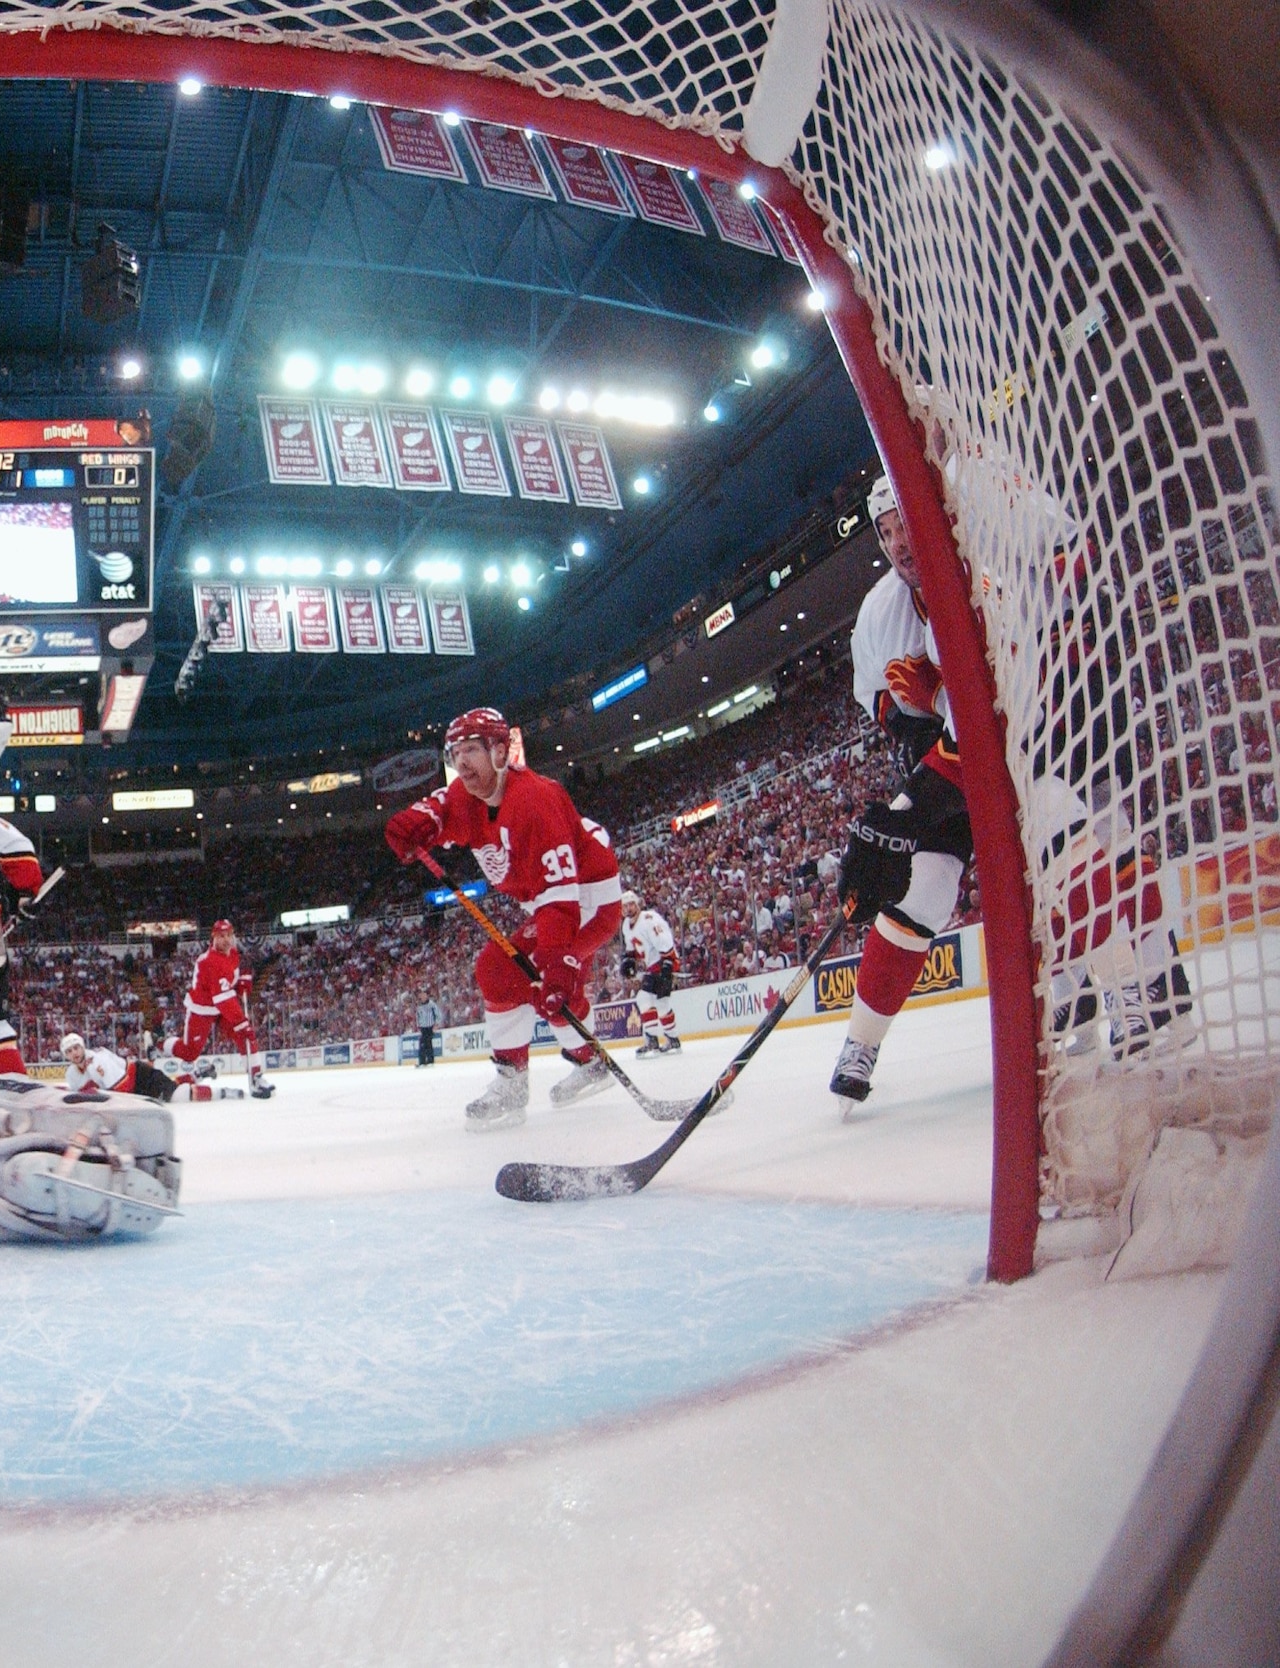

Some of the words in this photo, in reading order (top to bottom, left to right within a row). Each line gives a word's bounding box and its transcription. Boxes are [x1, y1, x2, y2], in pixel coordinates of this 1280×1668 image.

[395, 135, 438, 148] CENTRAL
[397, 144, 443, 157] DIVISION
[395, 154, 452, 168] CHAMPIONS
[279, 448, 312, 456] CENTRAL
[81, 454, 103, 465] RED
[107, 454, 140, 466] WINGS
[280, 457, 315, 465] DIVISION
[114, 468, 126, 485] 0
[277, 465, 320, 474] CHAMPIONS
[708, 608, 733, 632] MBNA
[19, 707, 80, 733] BRIGHTON
[10, 737, 57, 745] NATIO
[847, 822, 918, 853] ASTON
[541, 845, 577, 882] 33
[818, 966, 859, 1000] CASIN
[919, 944, 956, 981] SOR
[718, 983, 748, 996] MOLSON
[707, 992, 762, 1020] CANADIAN
[595, 1006, 626, 1021] KTOWN
